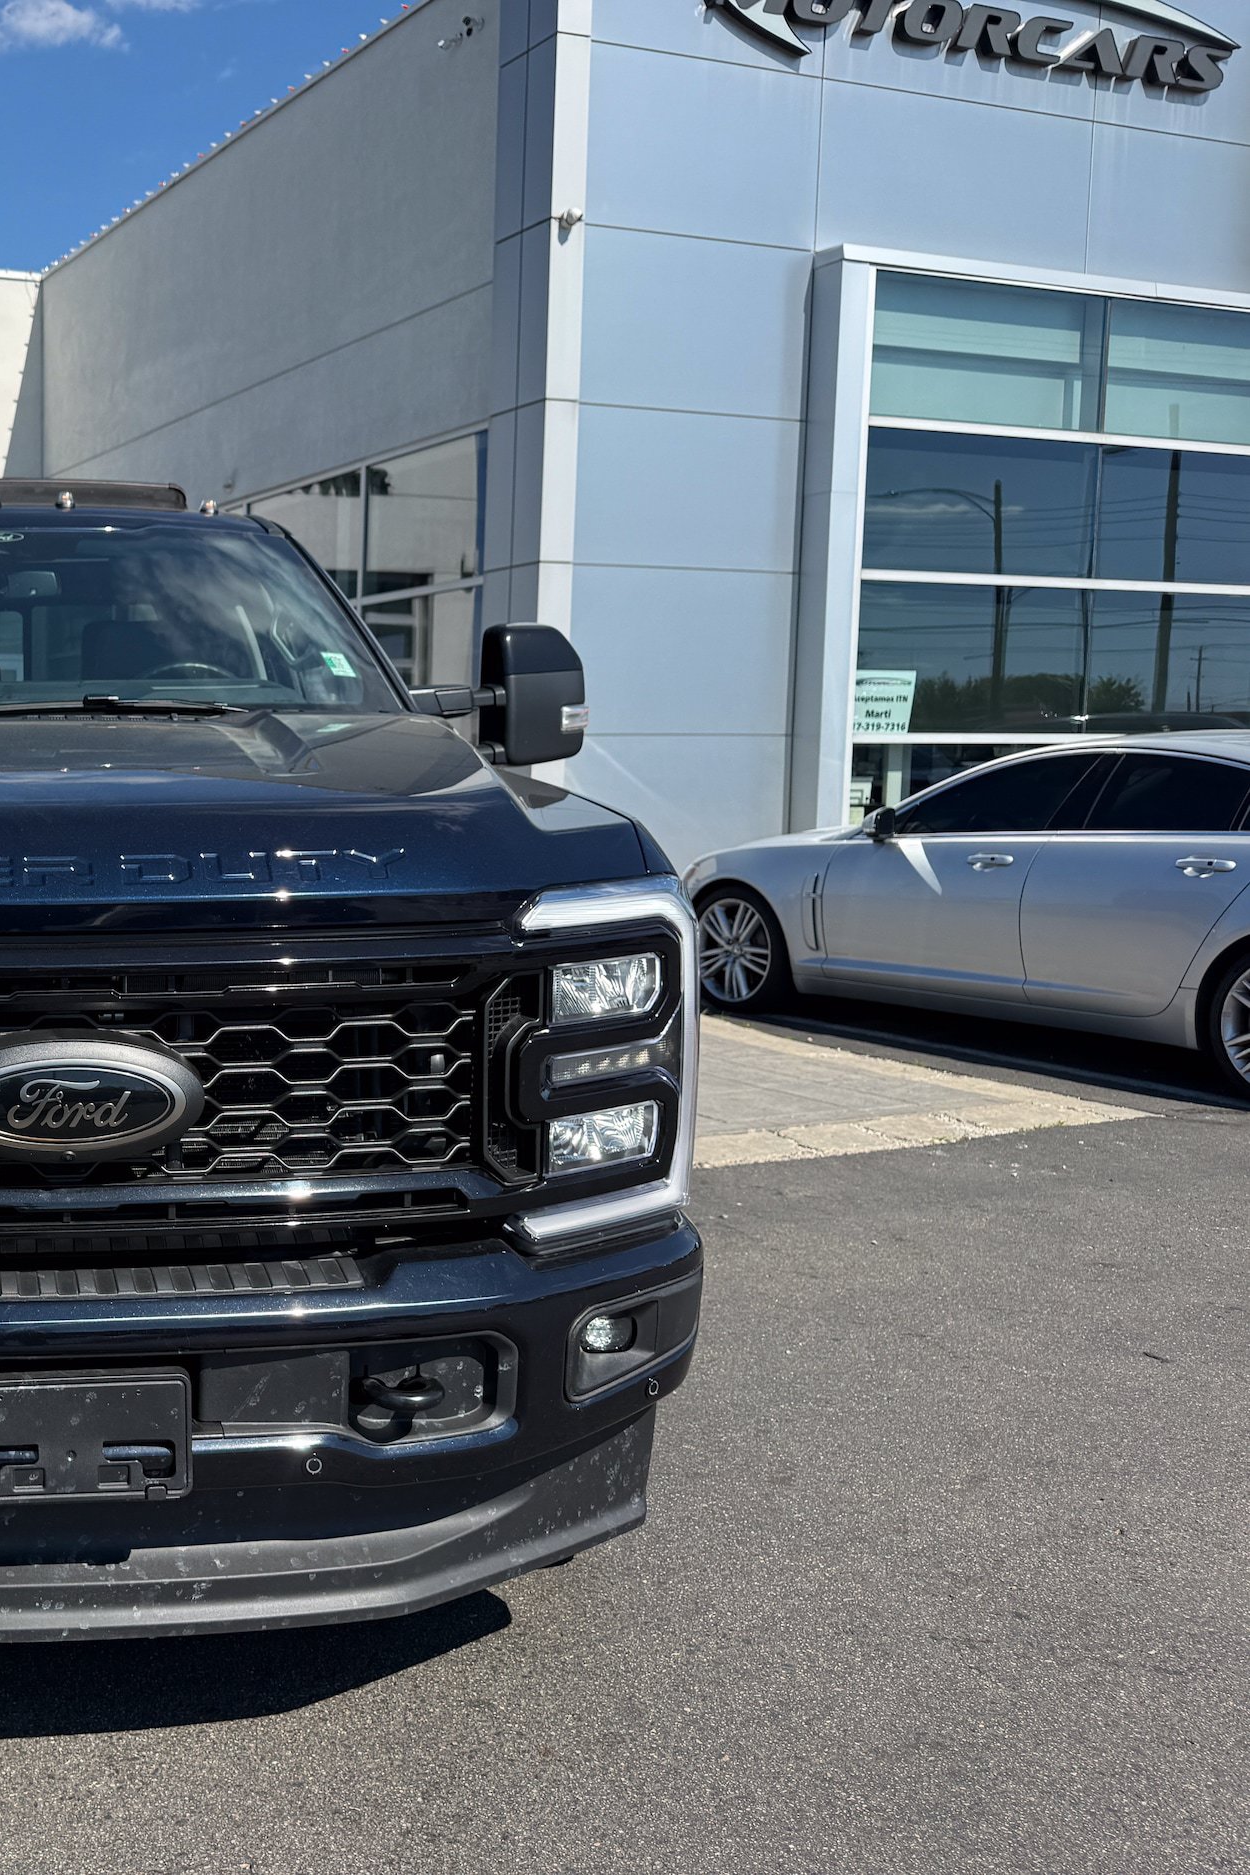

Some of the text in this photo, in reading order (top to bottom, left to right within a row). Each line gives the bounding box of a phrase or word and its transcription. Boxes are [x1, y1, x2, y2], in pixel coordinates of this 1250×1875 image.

[708, 0, 1233, 91] OTORCARS
[865, 709, 891, 718] Marti
[120, 848, 404, 885] DUTY
[6, 1079, 132, 1129] Ford
